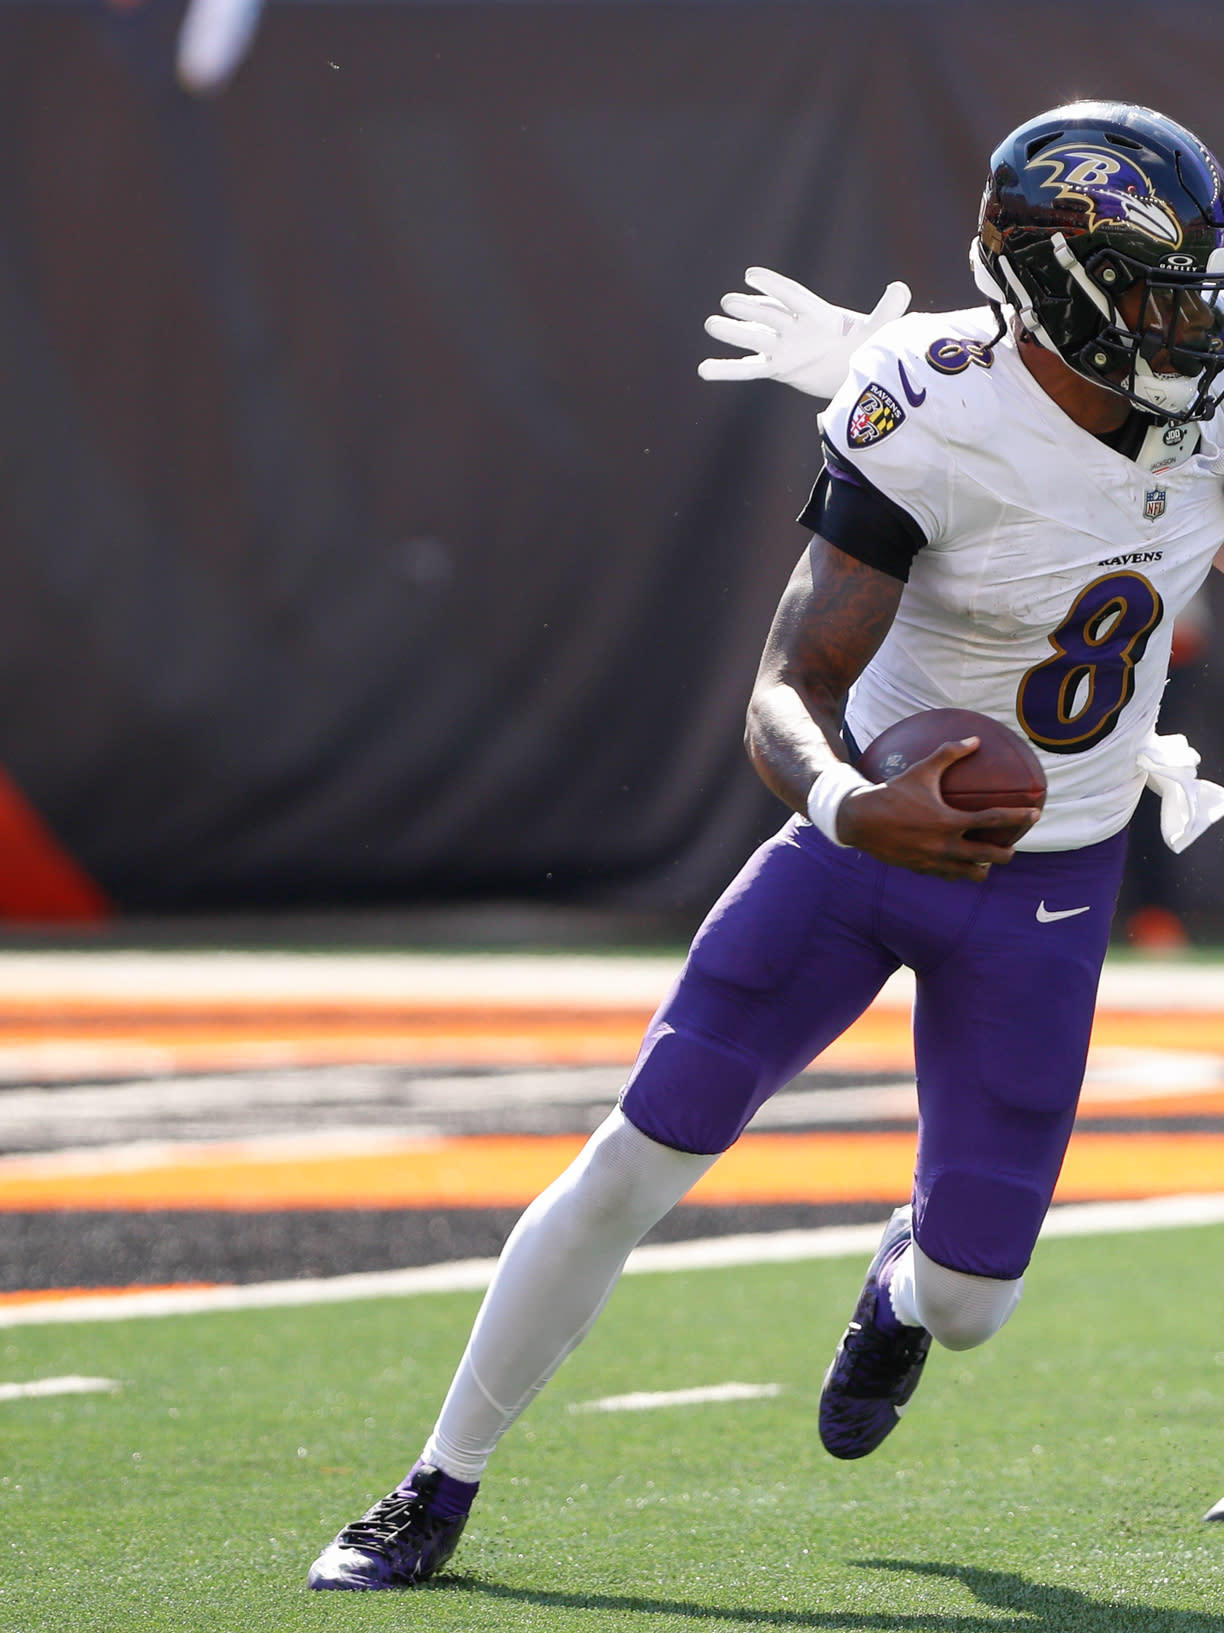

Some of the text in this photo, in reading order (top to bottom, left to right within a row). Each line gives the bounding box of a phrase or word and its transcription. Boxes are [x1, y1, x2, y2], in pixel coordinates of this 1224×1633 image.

[1064, 152, 1120, 185] B
[1160, 263, 1197, 272] OAKLEY
[925, 338, 994, 375] 8
[870, 384, 902, 418] RAVENS
[1147, 501, 1163, 515] NFL
[1016, 570, 1164, 754] 8
